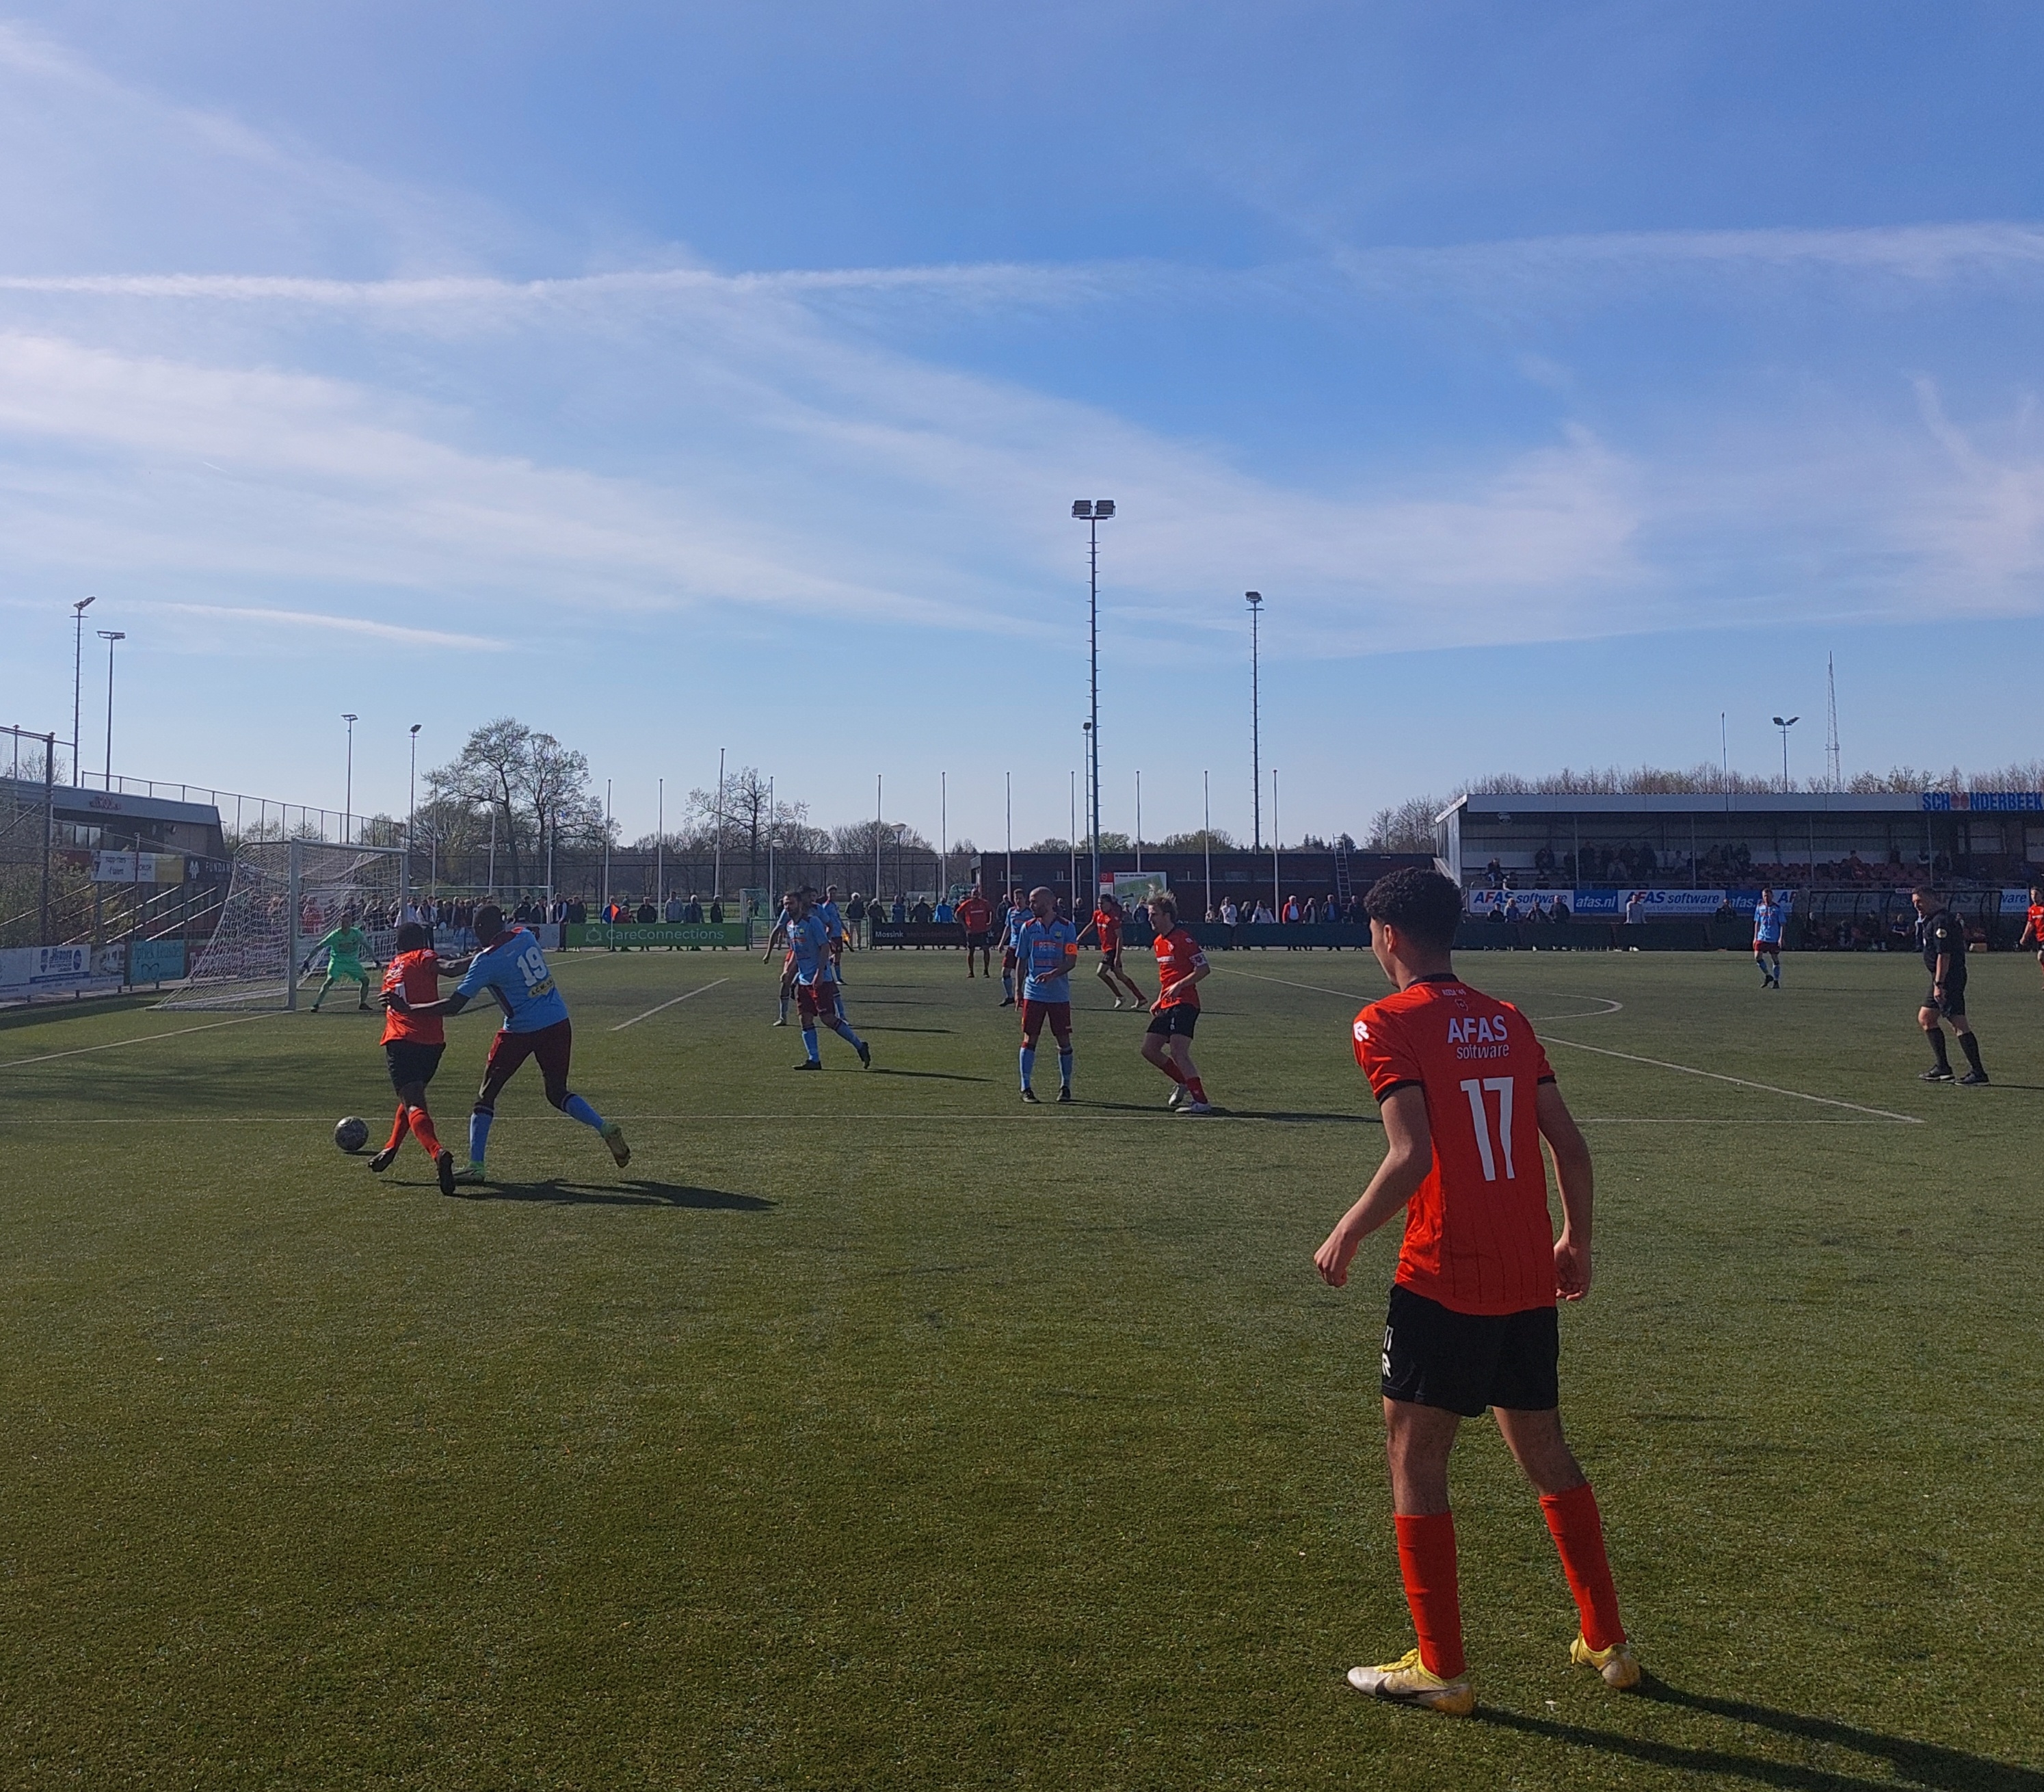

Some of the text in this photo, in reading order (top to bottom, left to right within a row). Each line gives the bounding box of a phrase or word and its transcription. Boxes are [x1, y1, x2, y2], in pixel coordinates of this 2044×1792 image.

[1576, 896, 1616, 908] afas.nl
[1667, 893, 1720, 904] software
[606, 928, 725, 940] CareConnections
[517, 947, 547, 987] 19
[1447, 1014, 1508, 1044] AFAS
[1457, 1044, 1509, 1059] software
[1460, 1077, 1515, 1182] 17
